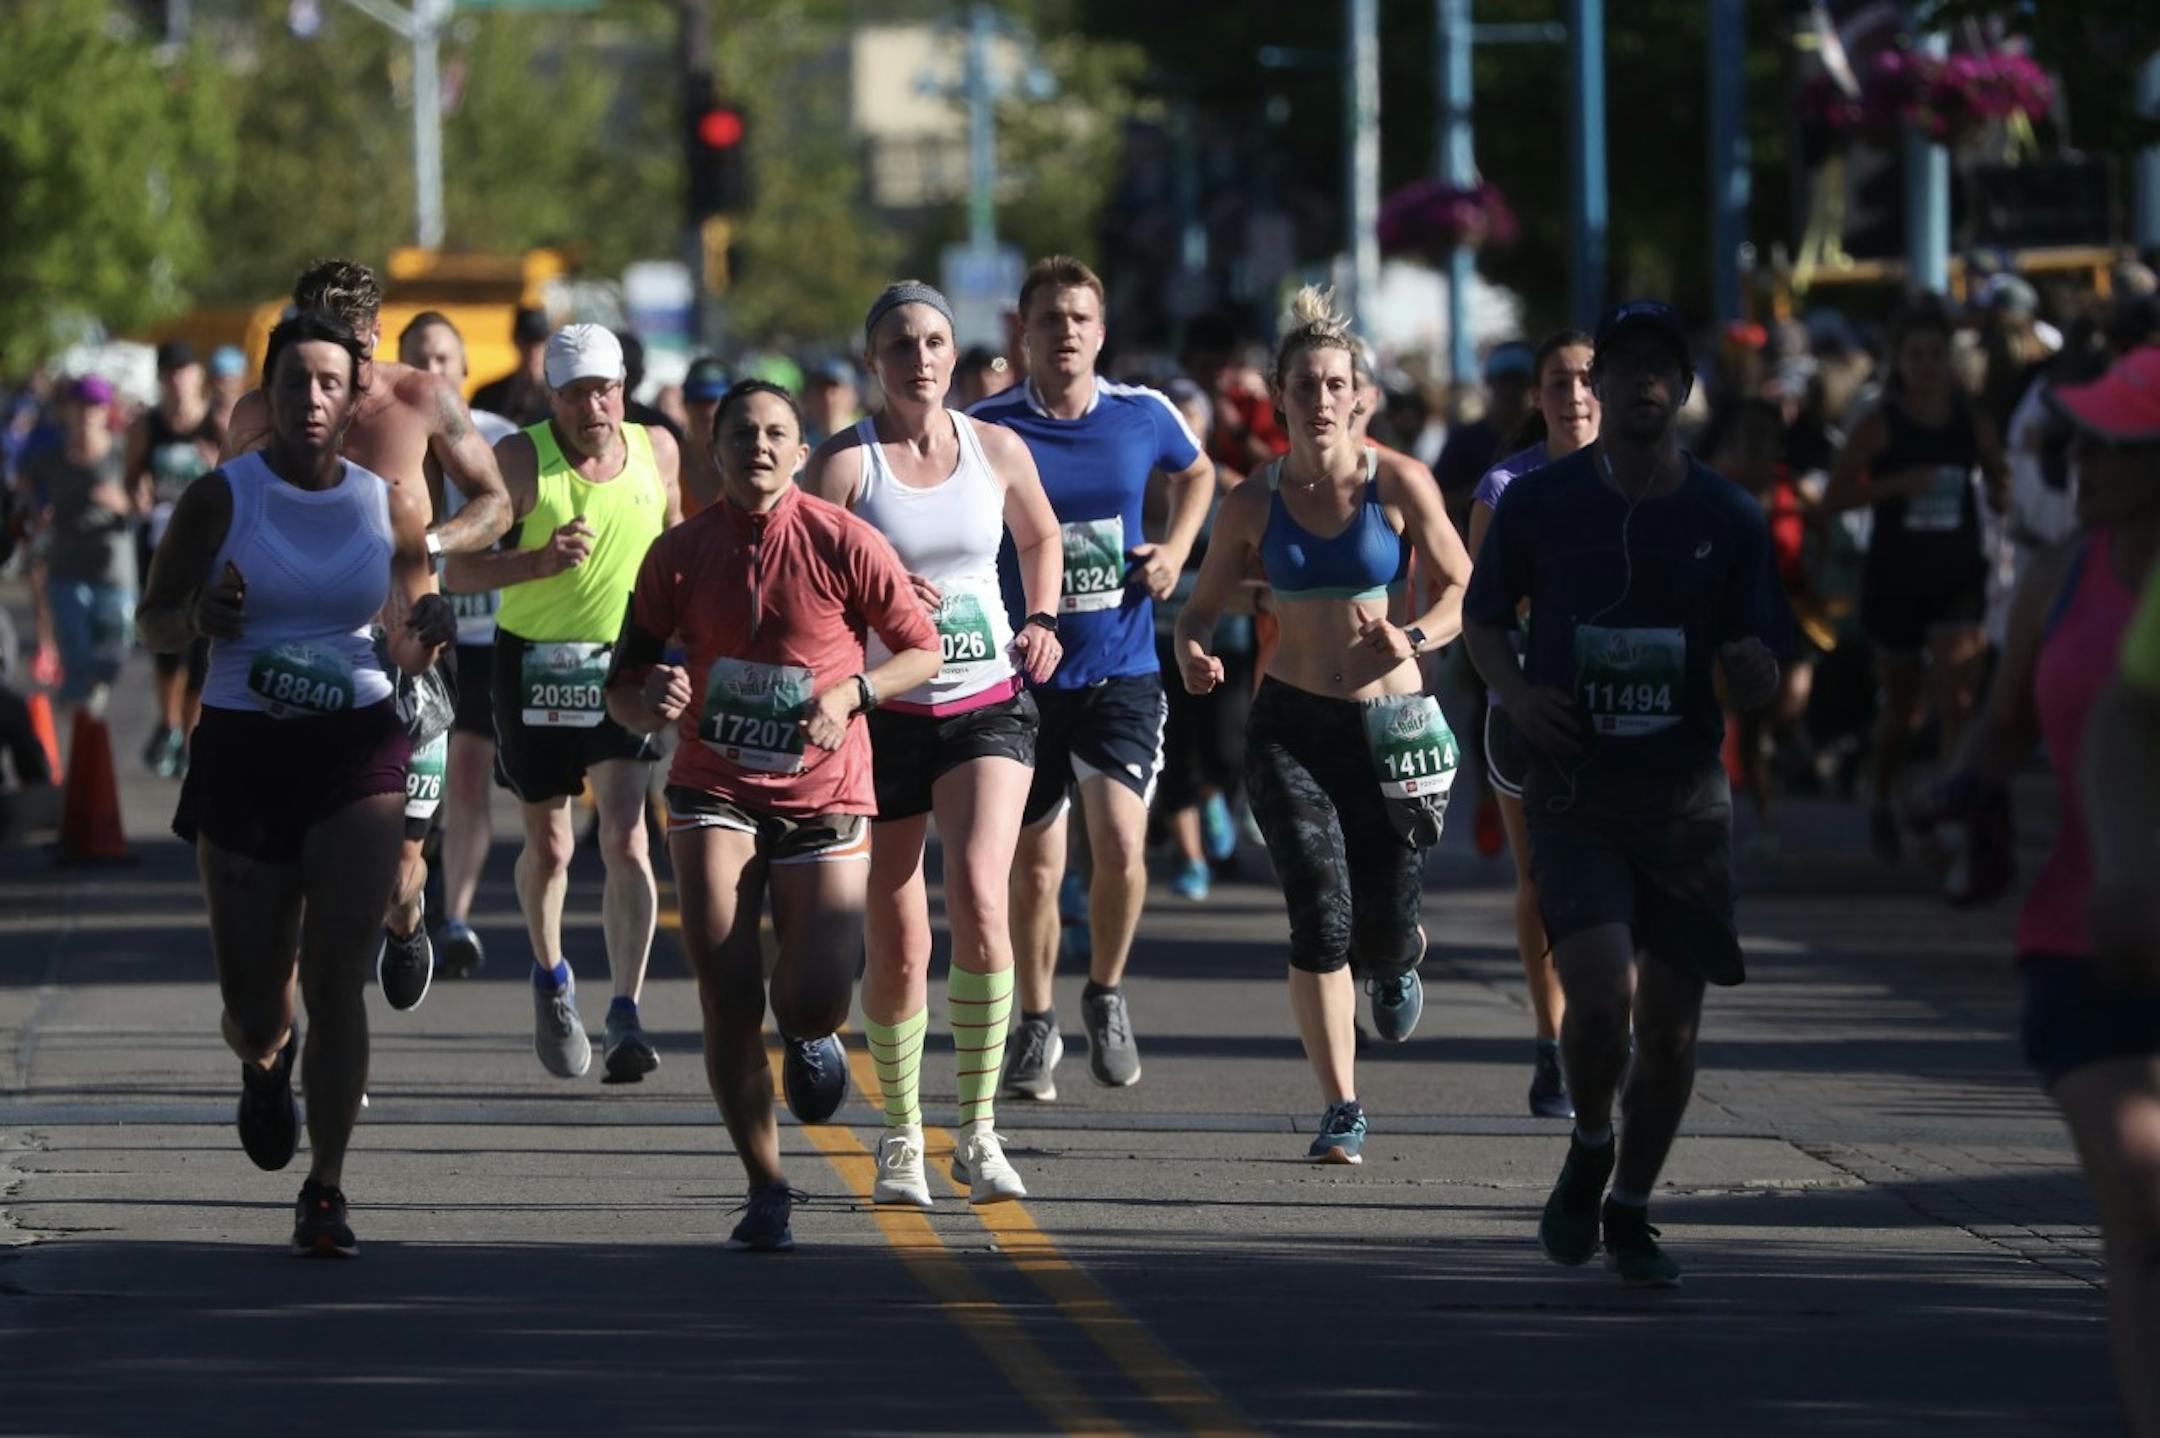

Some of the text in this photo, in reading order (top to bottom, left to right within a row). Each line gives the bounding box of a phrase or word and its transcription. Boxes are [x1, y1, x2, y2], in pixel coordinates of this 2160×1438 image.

[261, 668, 344, 711] 18840
[531, 684, 601, 708] 20350
[1584, 682, 1672, 712] 11494
[712, 712, 796, 749] 17207
[1384, 742, 1455, 779] 14114
